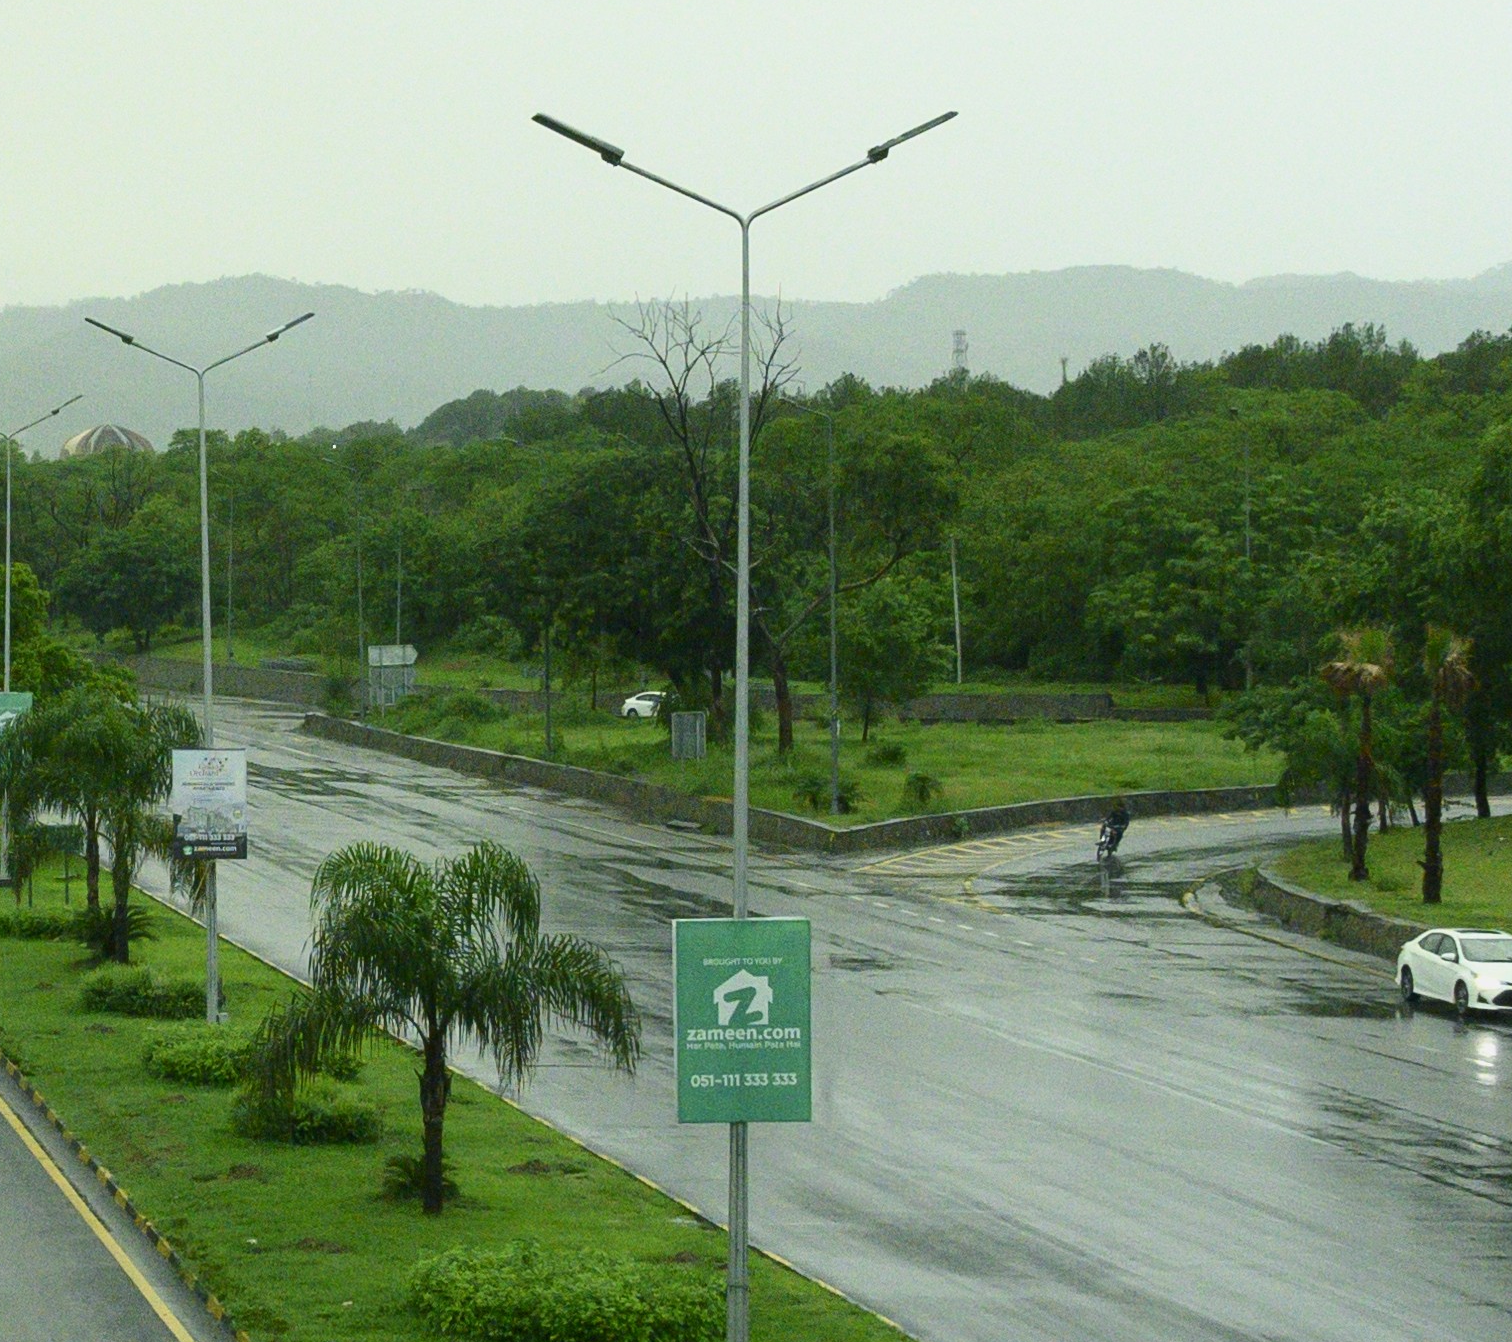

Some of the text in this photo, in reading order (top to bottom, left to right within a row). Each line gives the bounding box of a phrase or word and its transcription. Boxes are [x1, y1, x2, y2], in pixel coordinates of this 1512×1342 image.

[703, 958, 740, 966] BROUGHT
[772, 957, 783, 965] BY
[686, 1027, 801, 1041] zameen.com
[690, 1072, 797, 1087] 051-111 333 333
